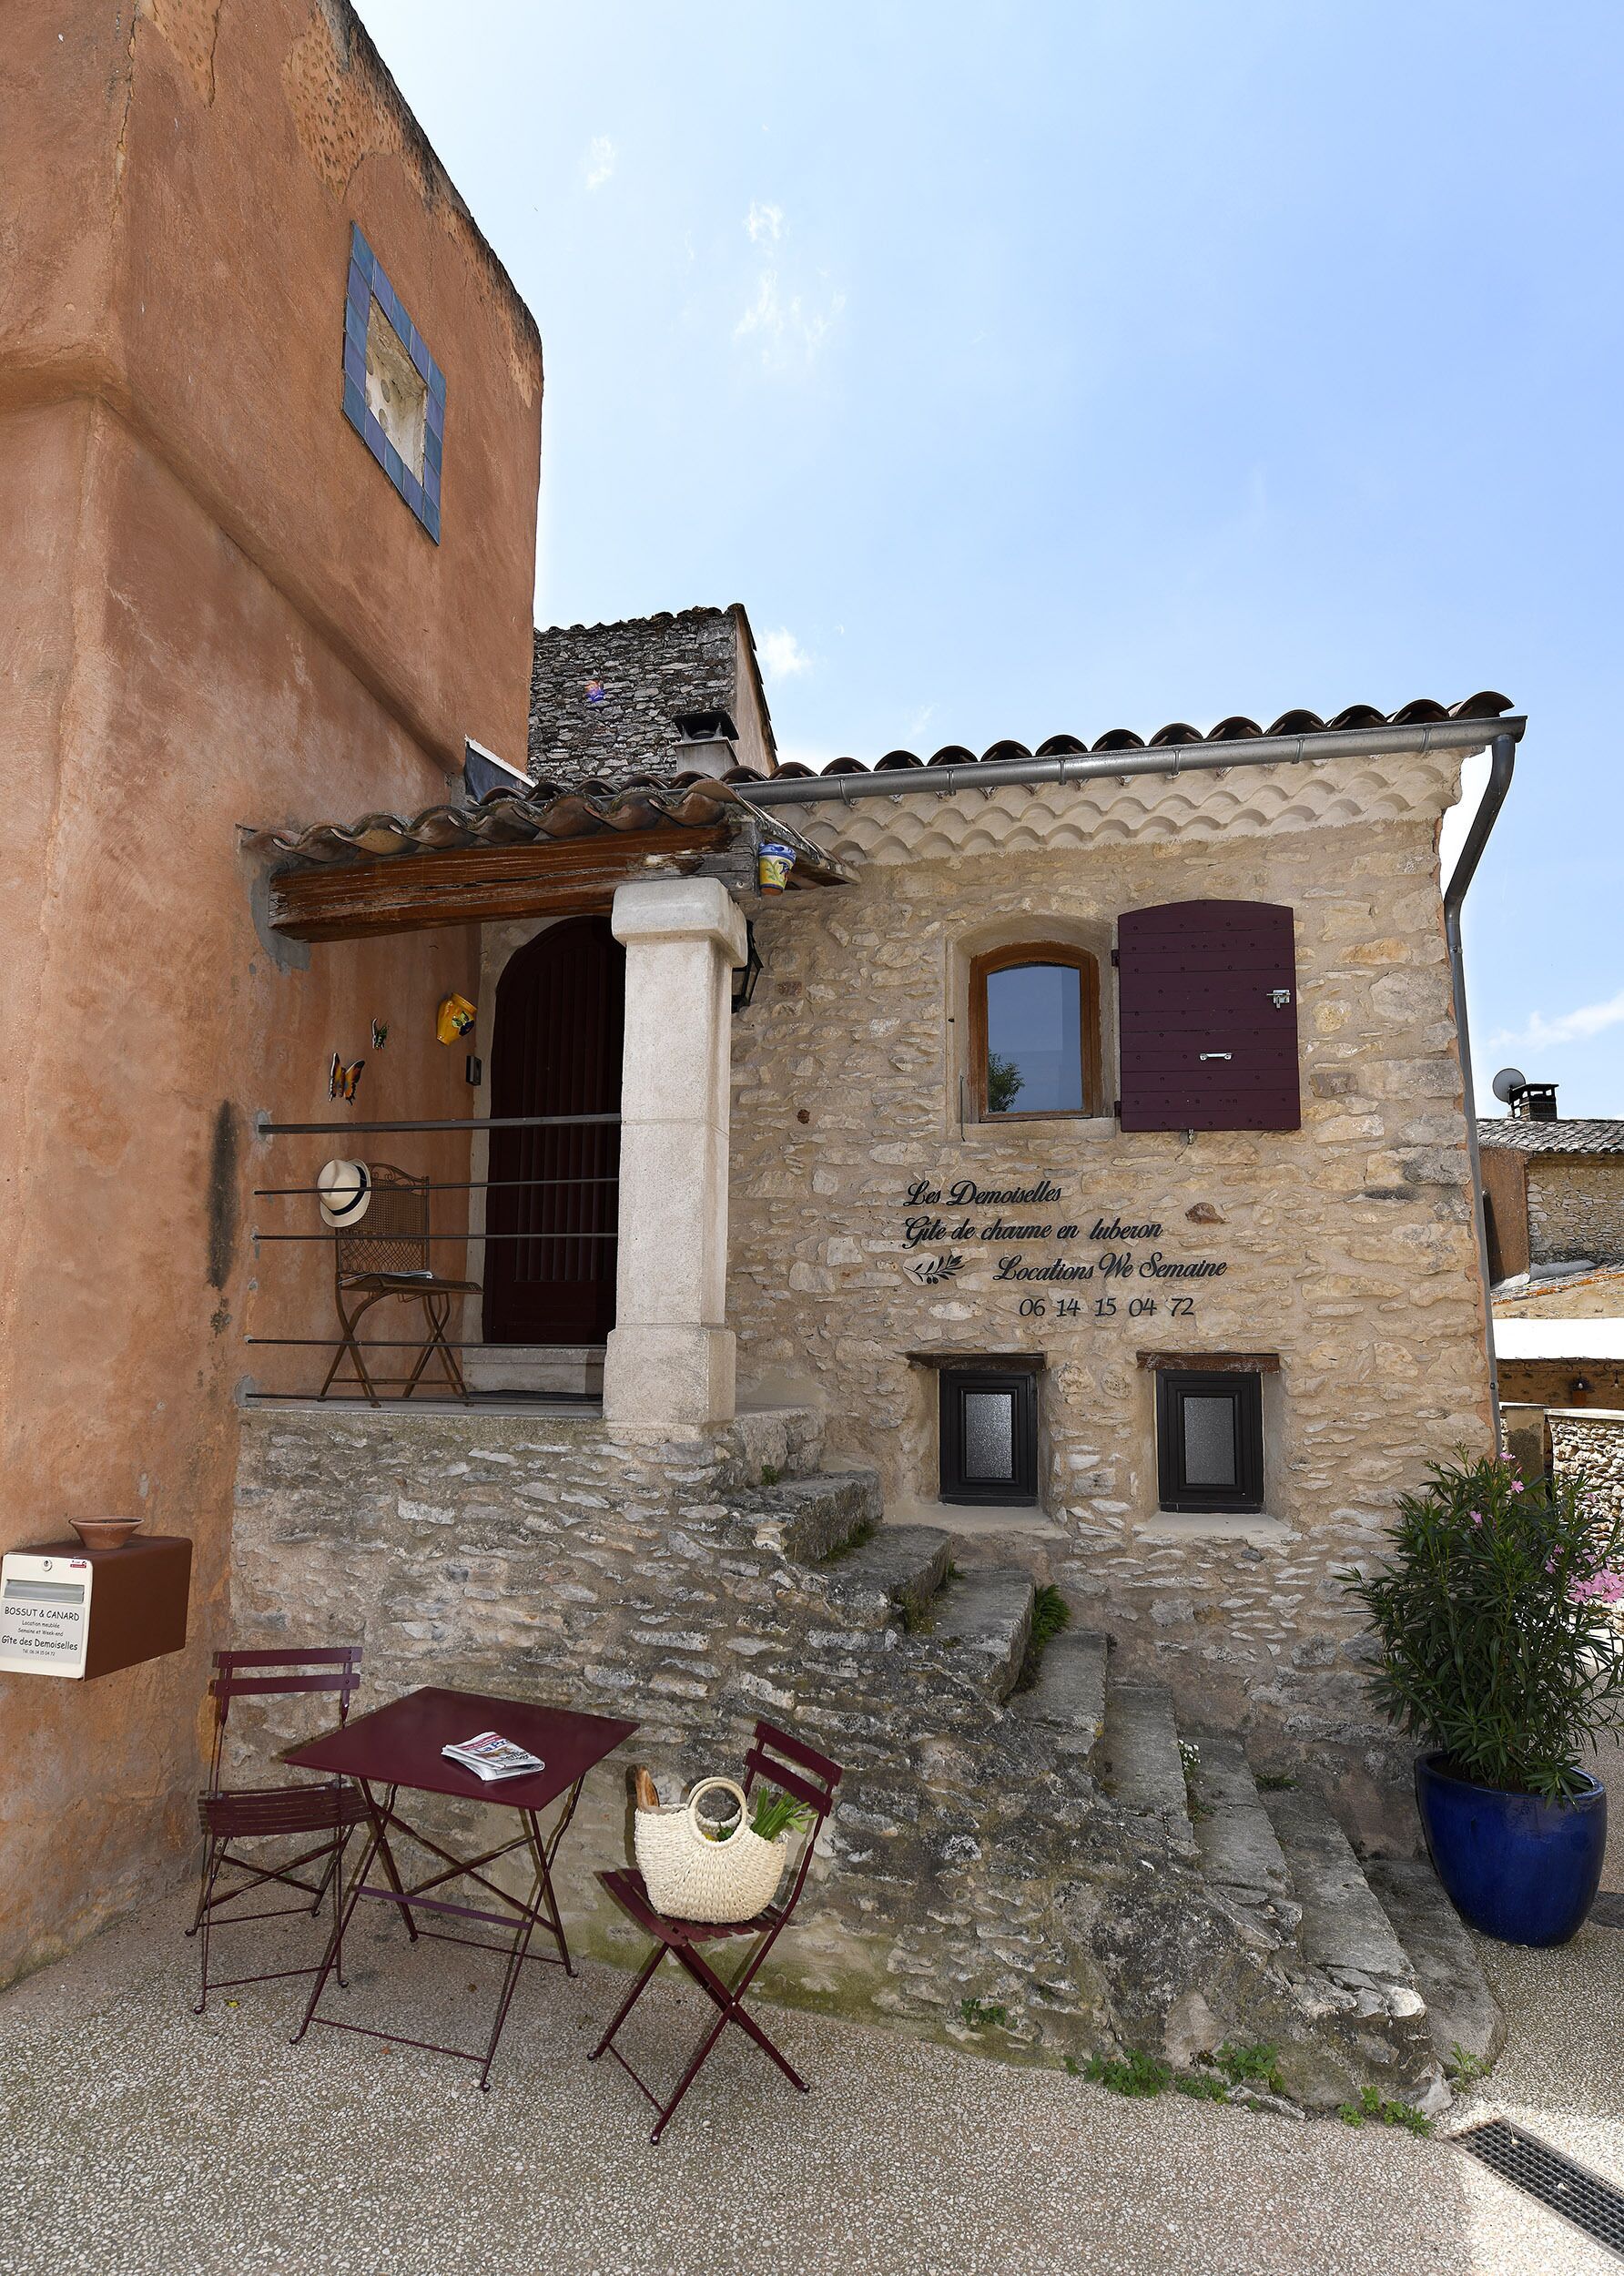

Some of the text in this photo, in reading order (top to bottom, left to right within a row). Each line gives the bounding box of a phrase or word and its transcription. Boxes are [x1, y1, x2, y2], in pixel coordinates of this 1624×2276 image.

[903, 1179, 1062, 1207] Les Demoiselles
[950, 1218, 976, 1240] de
[980, 1218, 1052, 1241] charme
[1057, 1224, 1080, 1239] en
[1089, 1218, 1163, 1240] luberon
[992, 1251, 1228, 1281] Locations We Semaine
[1019, 1297, 1195, 1317] 06 14 15 04 72
[5, 1606, 80, 1621] BOSSUT & CANARD
[1, 1635, 78, 1651] Gîte des Demoiselles
